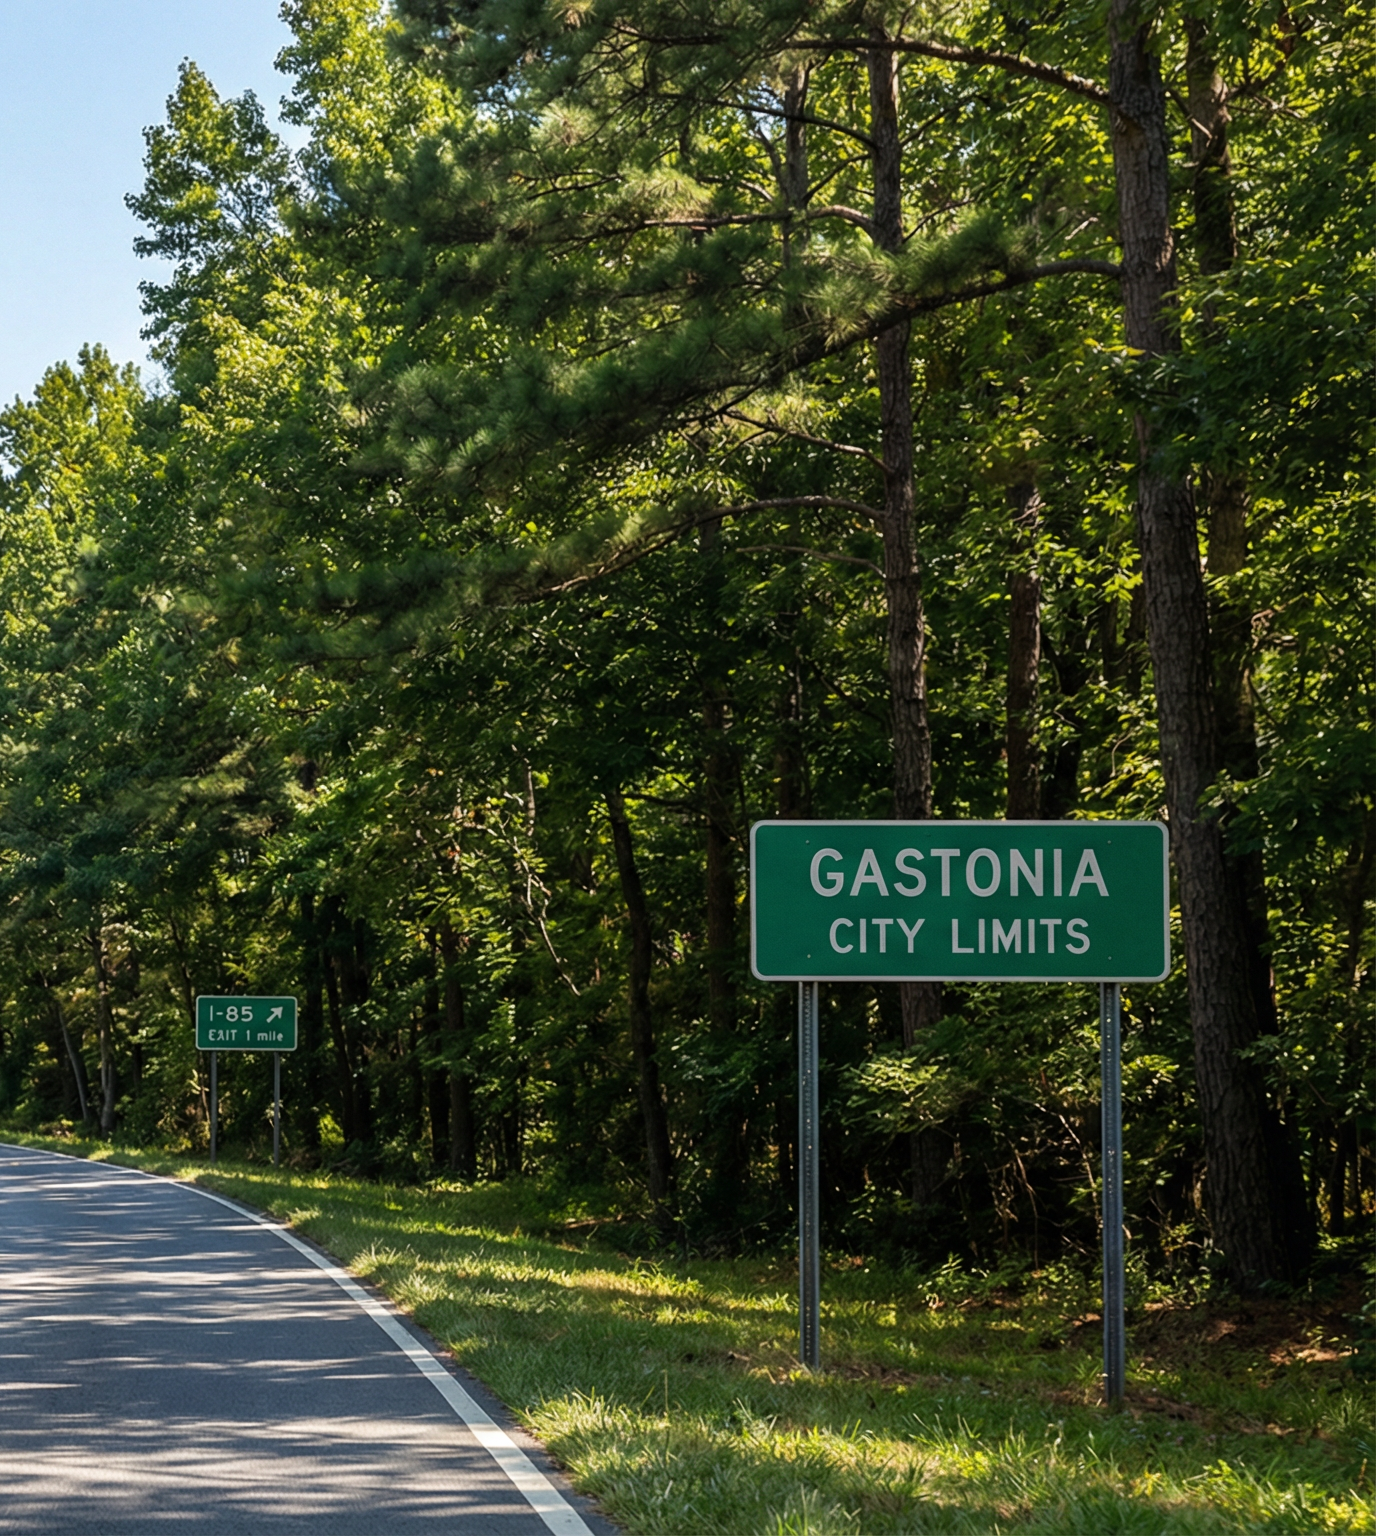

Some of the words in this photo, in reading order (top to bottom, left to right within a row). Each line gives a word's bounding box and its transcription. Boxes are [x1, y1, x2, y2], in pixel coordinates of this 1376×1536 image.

[810, 847, 1110, 897] GASTONIA
[829, 917, 926, 954] CITY
[951, 917, 1091, 955] LIMITS
[209, 1005, 254, 1022] I-85
[246, 1029, 251, 1041] 1
[257, 1031, 284, 1042] mile
